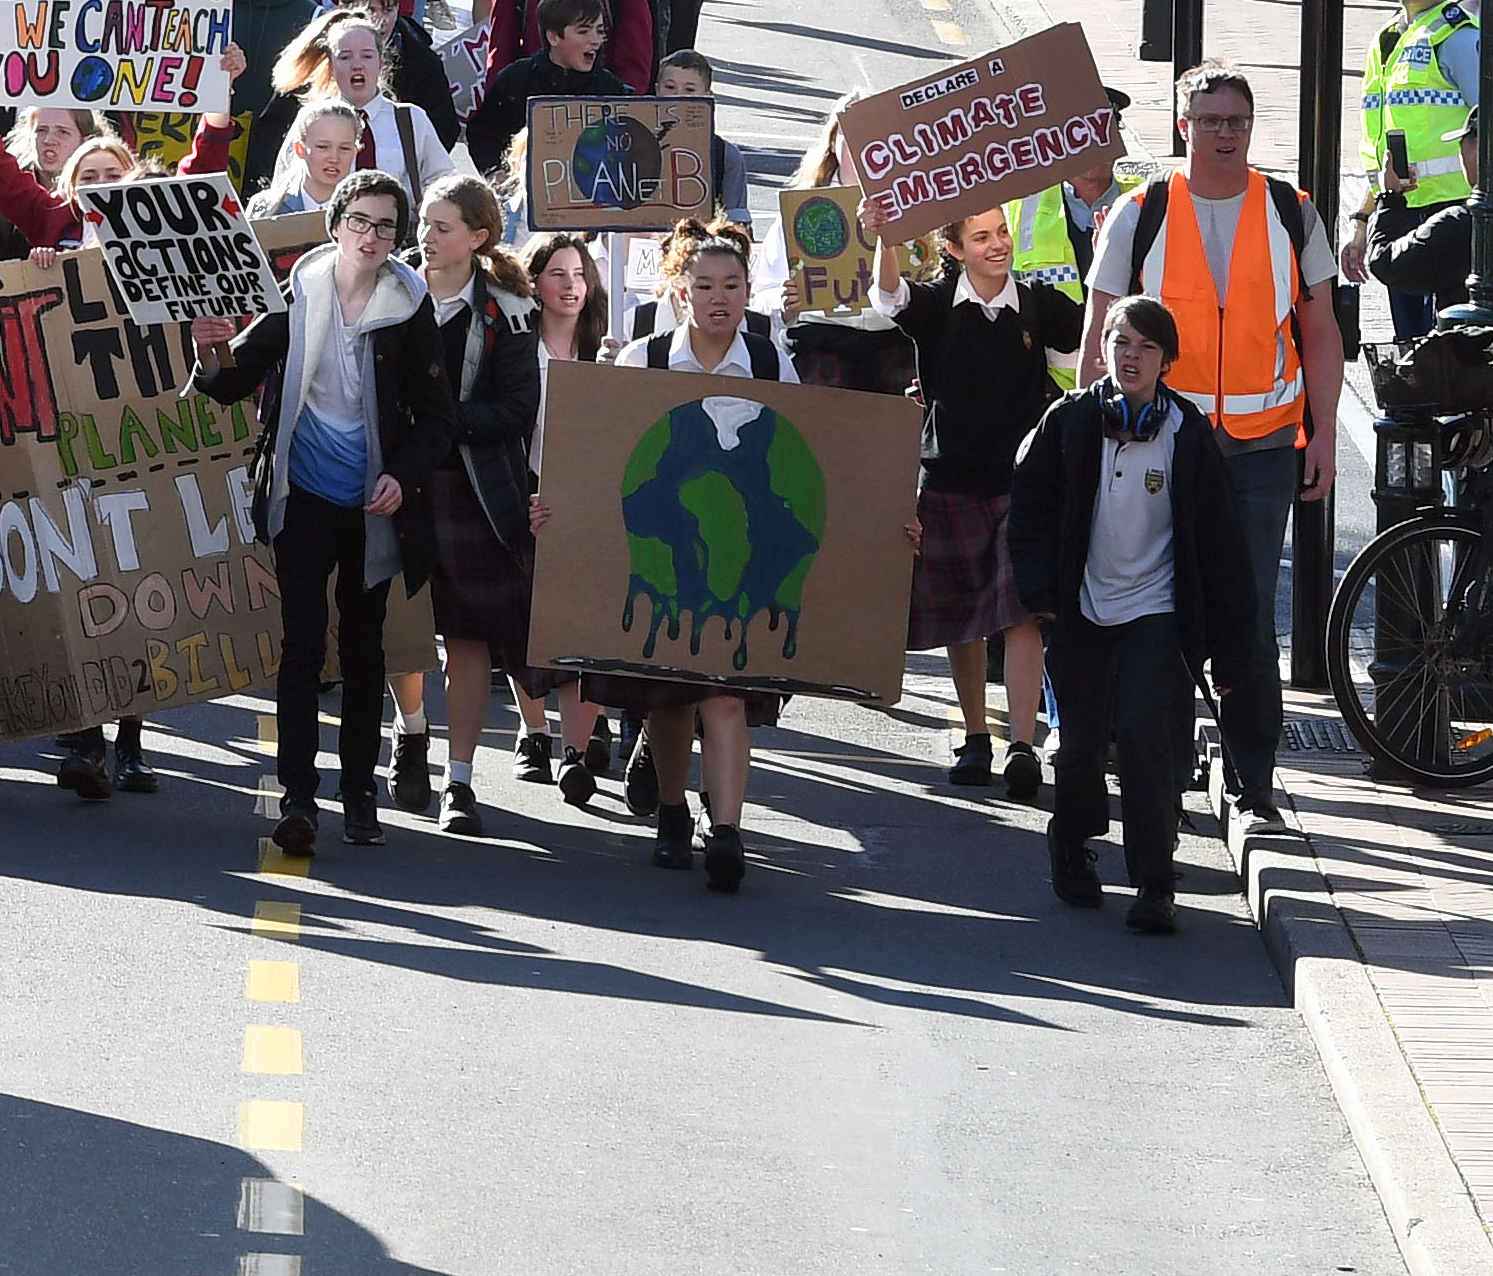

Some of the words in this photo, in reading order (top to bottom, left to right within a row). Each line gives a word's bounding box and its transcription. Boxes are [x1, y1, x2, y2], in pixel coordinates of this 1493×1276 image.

[900, 68, 979, 110] DECLARE
[989, 57, 1005, 76] A
[543, 103, 628, 128] THERE
[654, 106, 683, 126] IS
[860, 81, 1047, 180] CLIMATE
[605, 131, 633, 153] NO
[871, 106, 1115, 222] EMERGENCY
[87, 182, 233, 239] YOUR
[123, 273, 213, 303] DEFINE
[216, 270, 265, 296] OUR
[167, 292, 269, 321] FUTURES
